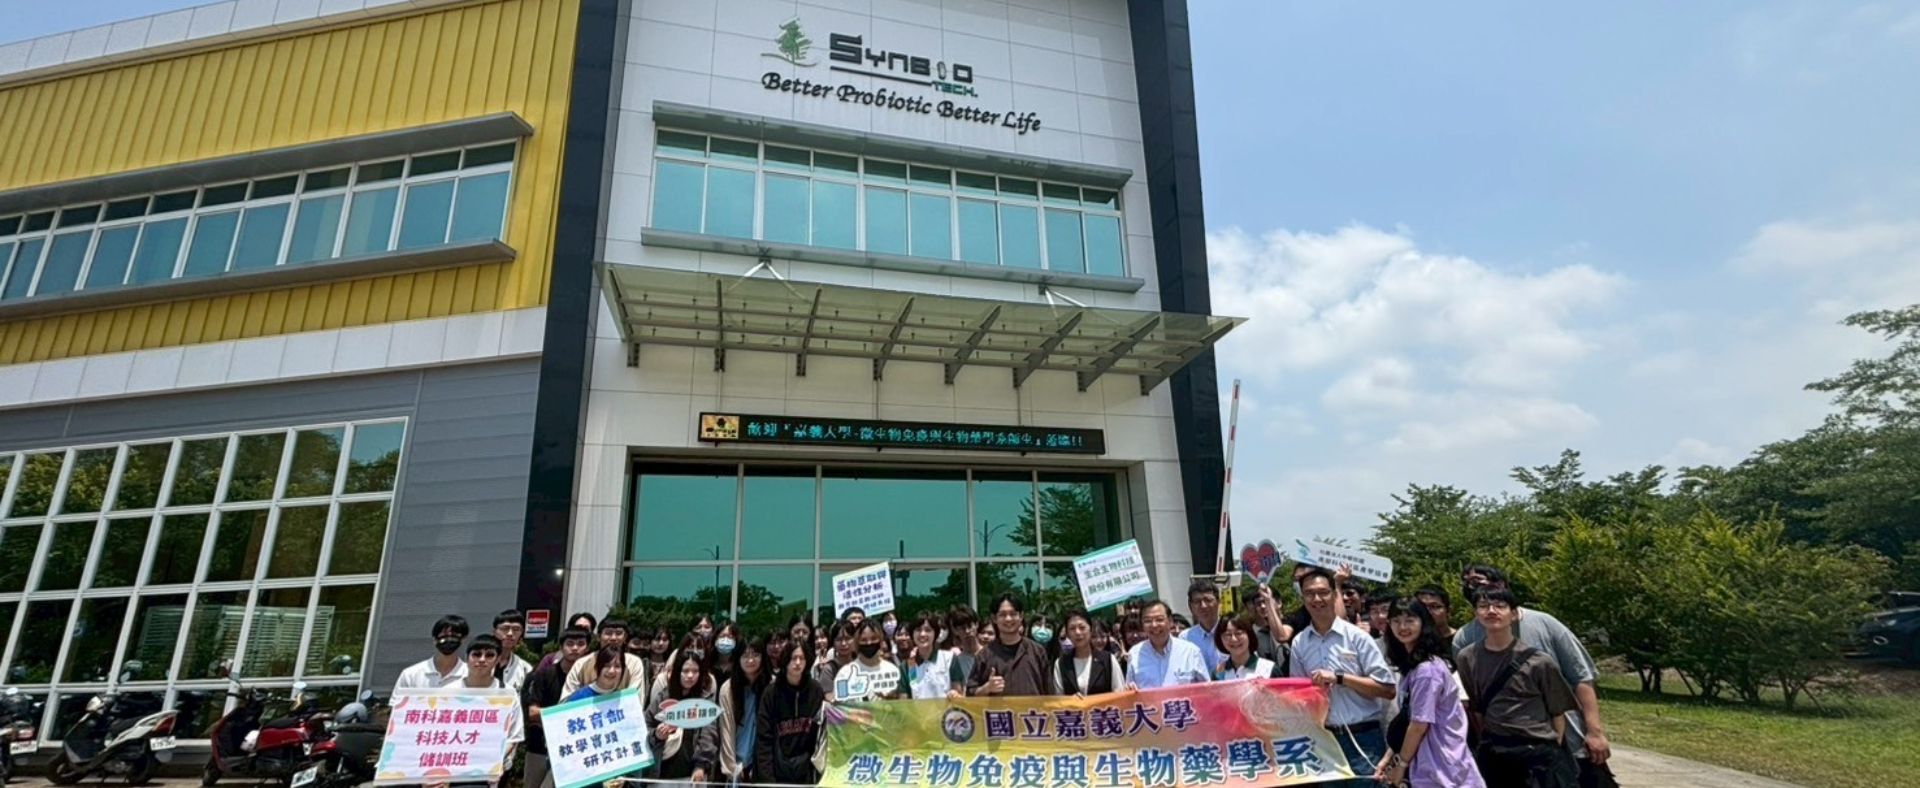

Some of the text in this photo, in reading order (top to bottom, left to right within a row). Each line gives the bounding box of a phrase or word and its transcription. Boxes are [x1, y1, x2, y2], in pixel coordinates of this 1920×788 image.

[761, 71, 1042, 135] Better Probiotic Better Life
[1084, 556, 1135, 579] 生合生物科技
[1088, 571, 1141, 595] 股份有限公司
[404, 709, 499, 724] 南科嘉義園區
[566, 708, 625, 735] 教育部
[984, 698, 1199, 741] 國立嘉義大學
[415, 729, 481, 746] 科技人才
[418, 751, 468, 768] 儲訓班
[583, 740, 643, 768] 研究計畫
[846, 735, 1326, 788] 微生物免疫與生物藥學系
